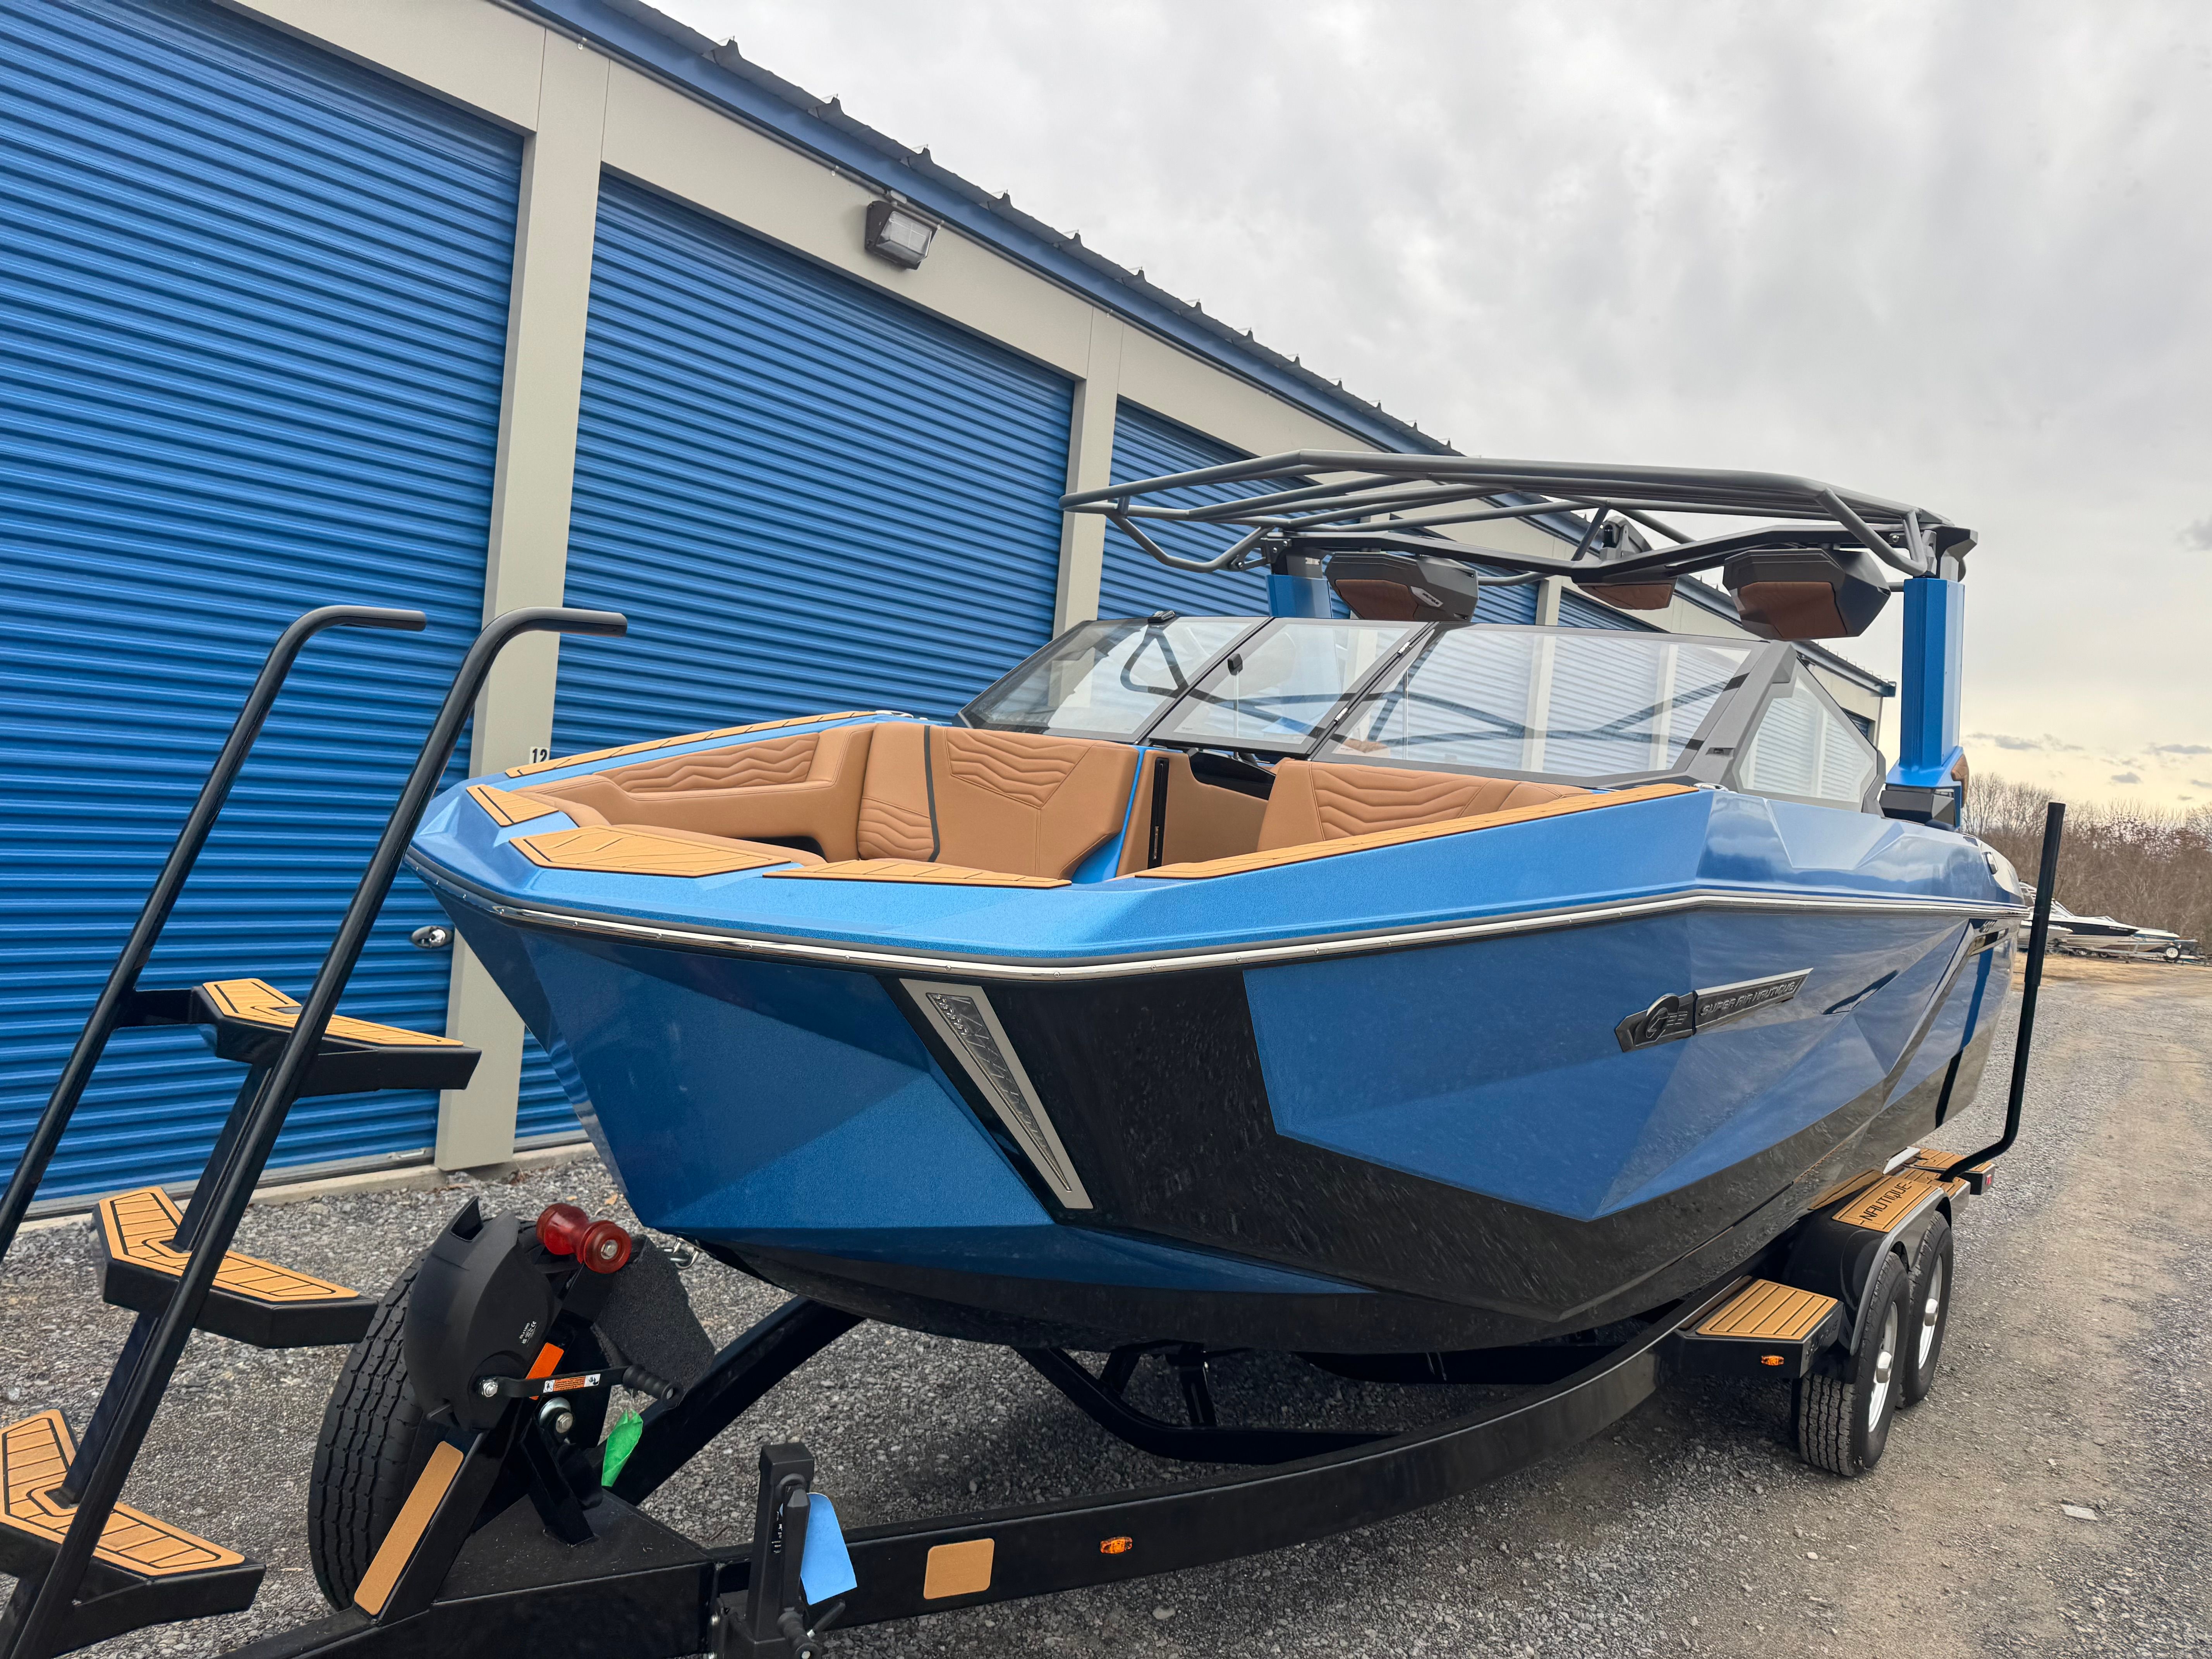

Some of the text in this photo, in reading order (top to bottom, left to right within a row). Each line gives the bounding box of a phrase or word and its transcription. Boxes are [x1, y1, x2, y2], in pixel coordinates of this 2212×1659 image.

[532, 748, 548, 763] 12
[1700, 982, 1795, 1016] SUPER AIR NAUTIQUE
[1859, 1182, 1912, 1221] NAUTIQUE
